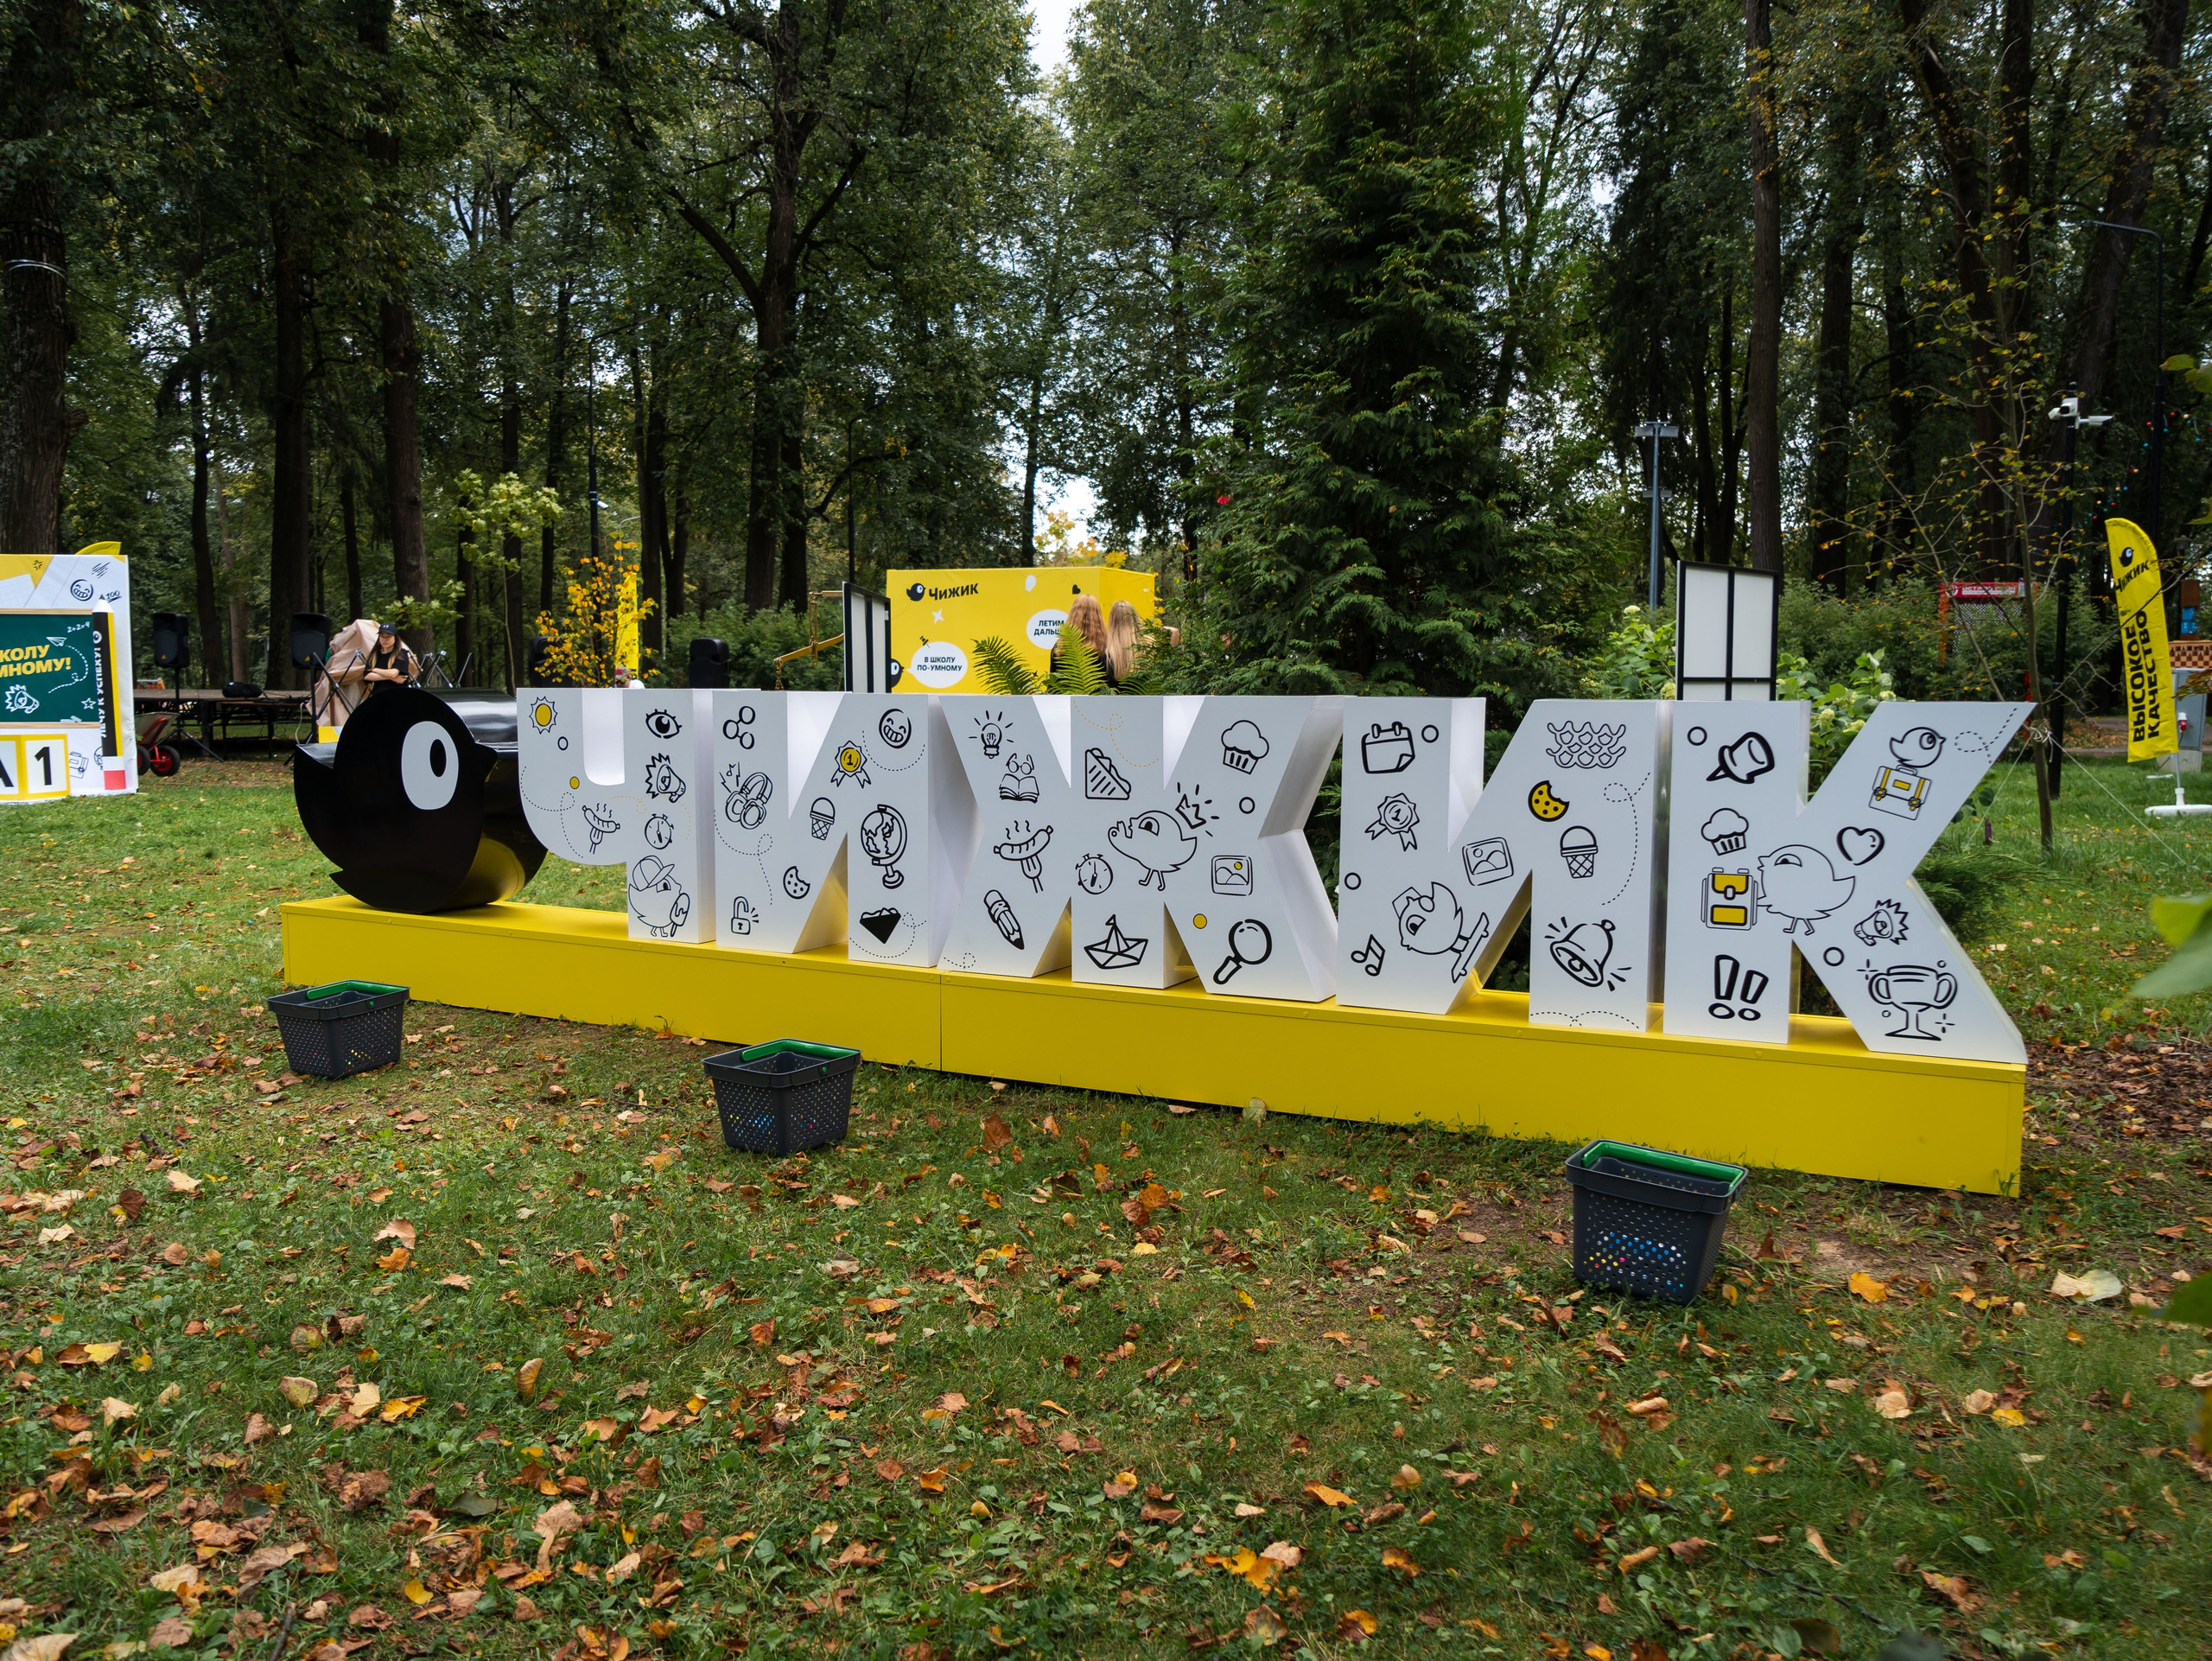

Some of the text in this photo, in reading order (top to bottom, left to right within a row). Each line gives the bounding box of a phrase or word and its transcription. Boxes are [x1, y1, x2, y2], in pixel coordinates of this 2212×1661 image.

[93, 647, 107, 739] ЛЕЧУ К УСПЕХУ!
[2125, 624, 2146, 742] ВЫСОКОЕ
[2135, 609, 2160, 739] КАЧЕСТВО
[34, 746, 53, 786] 1
